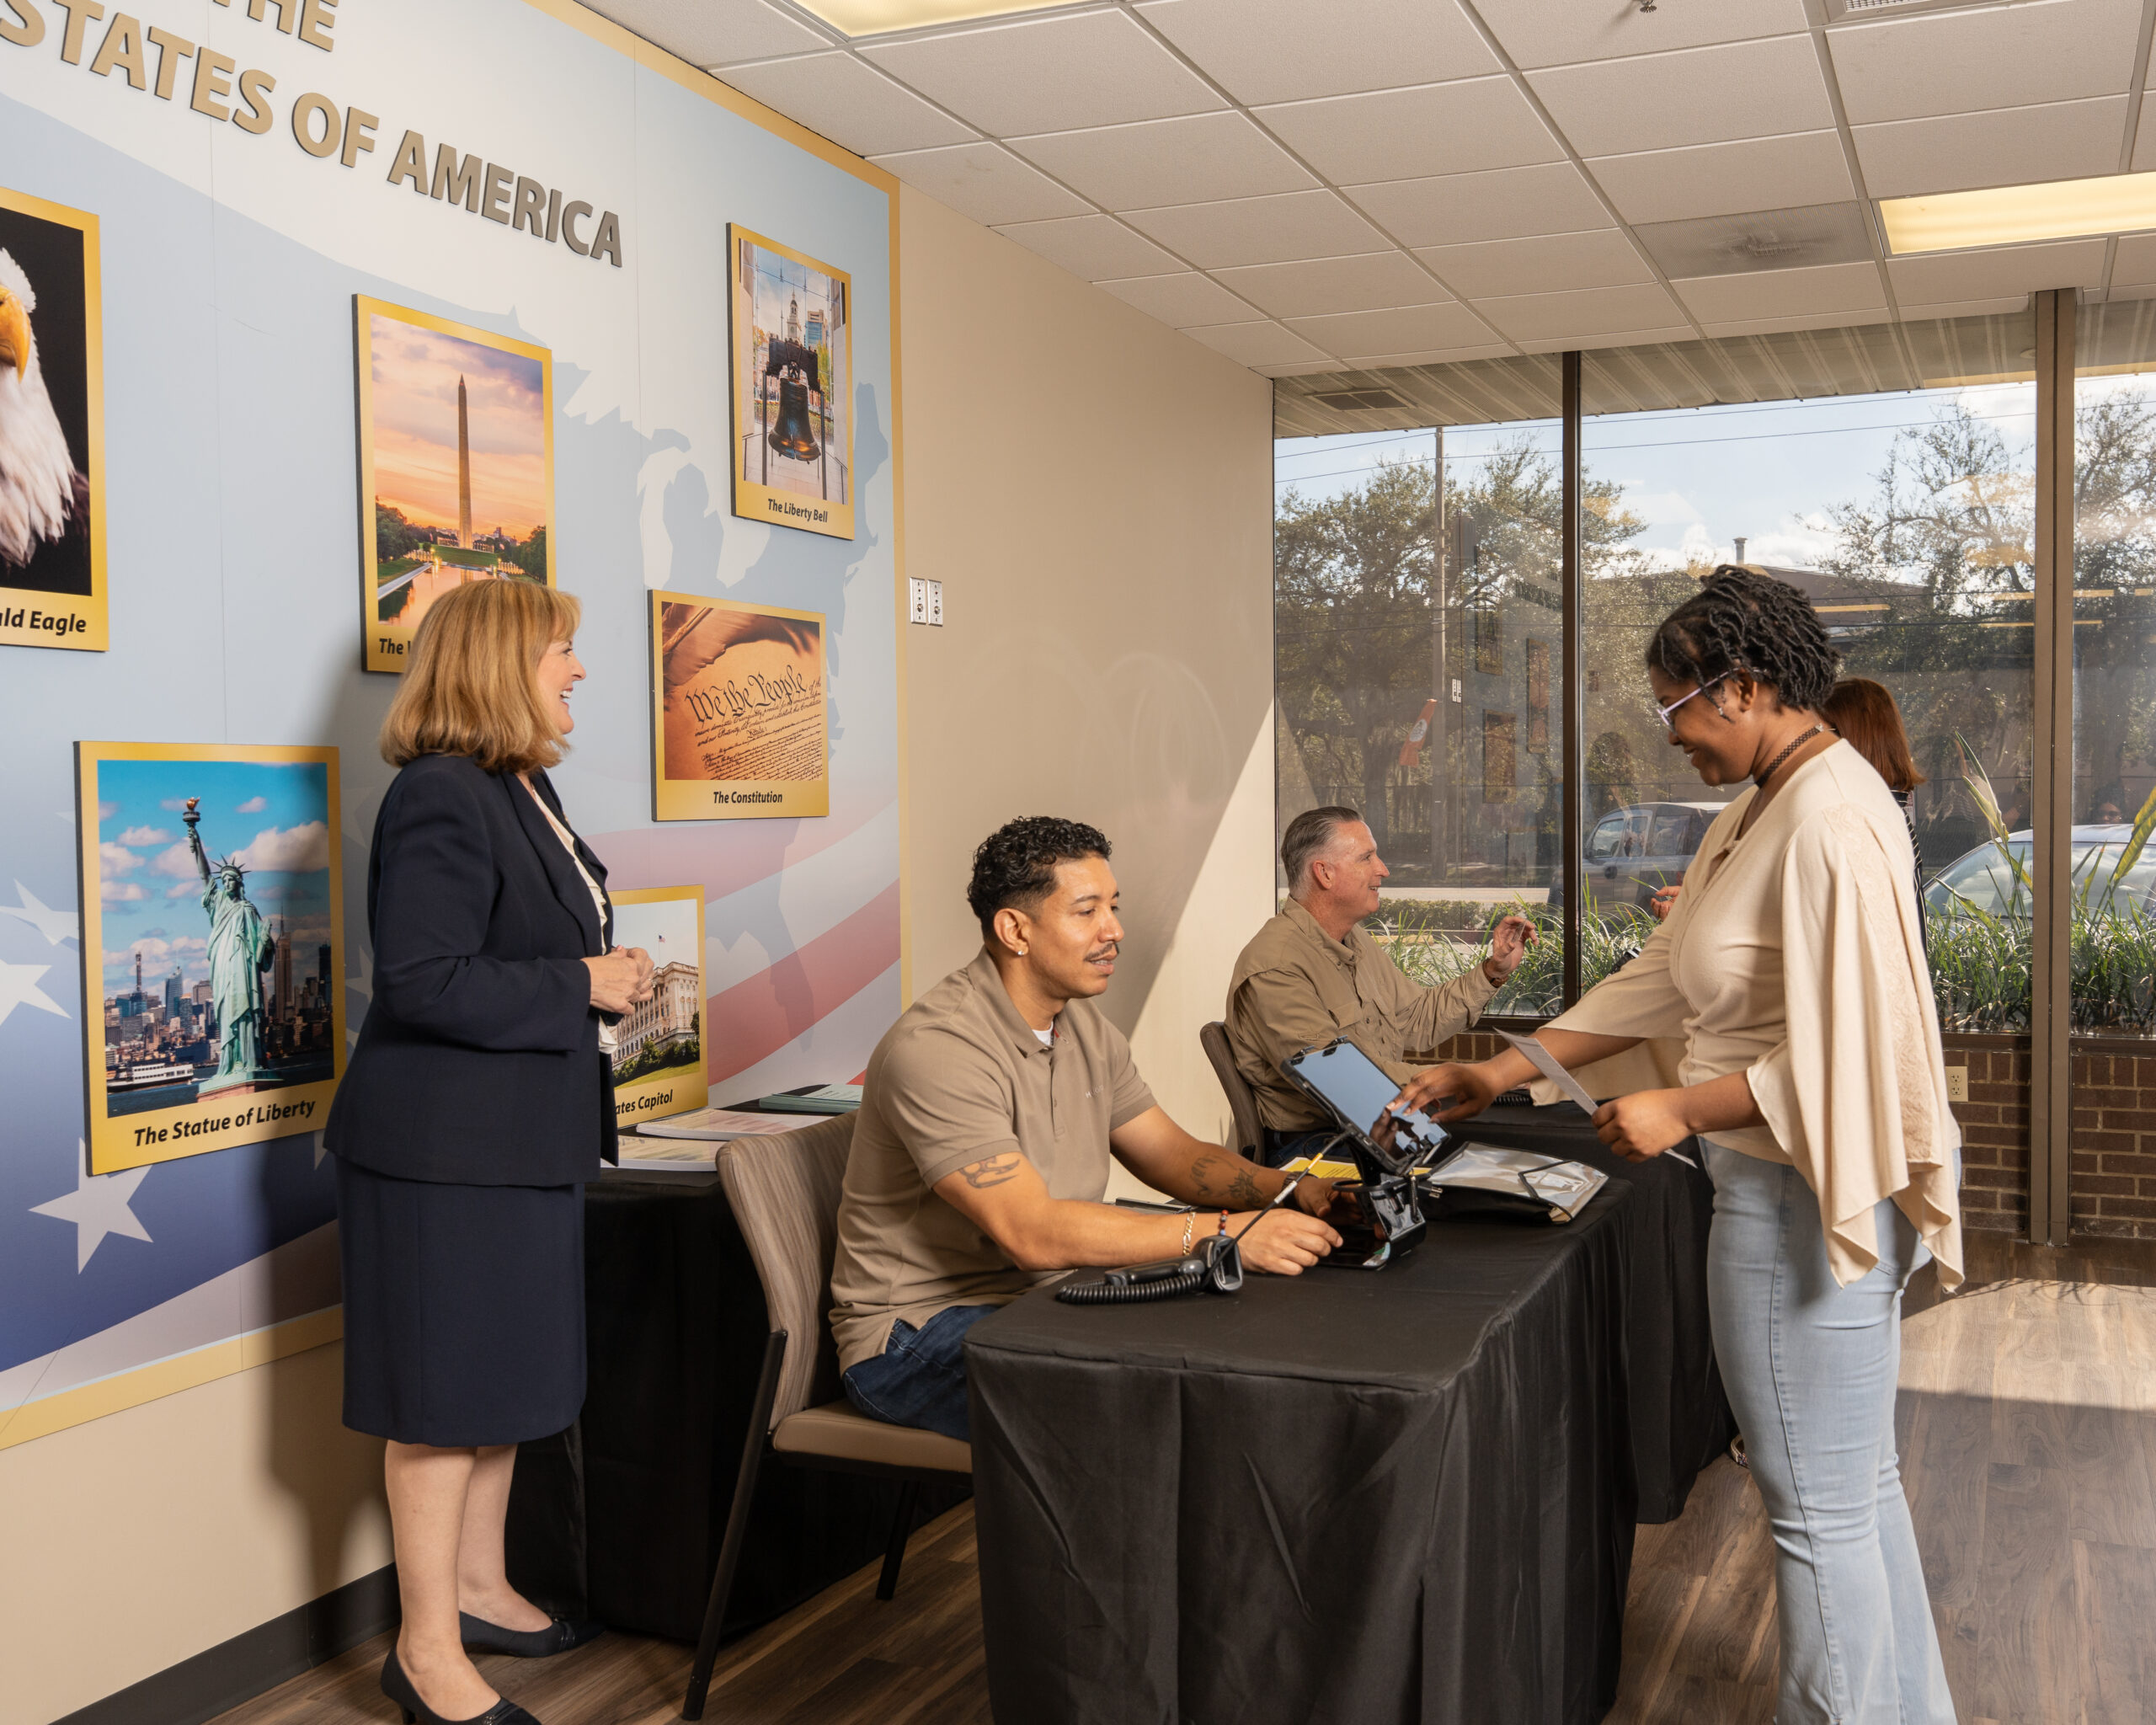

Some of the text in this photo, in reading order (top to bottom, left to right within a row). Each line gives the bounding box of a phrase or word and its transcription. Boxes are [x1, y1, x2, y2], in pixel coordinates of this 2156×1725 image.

[0, 0, 622, 268] STATES OF AMERICA
[767, 498, 828, 523] The Liberty Bell
[0, 607, 87, 637] ld Eagle
[379, 638, 403, 654] The
[685, 686, 726, 725] We
[723, 680, 753, 717] the
[748, 665, 807, 707] People
[713, 790, 783, 804] The Constitution
[638, 1088, 673, 1110] Capitol
[133, 1100, 316, 1146] The Statue of Liberty
